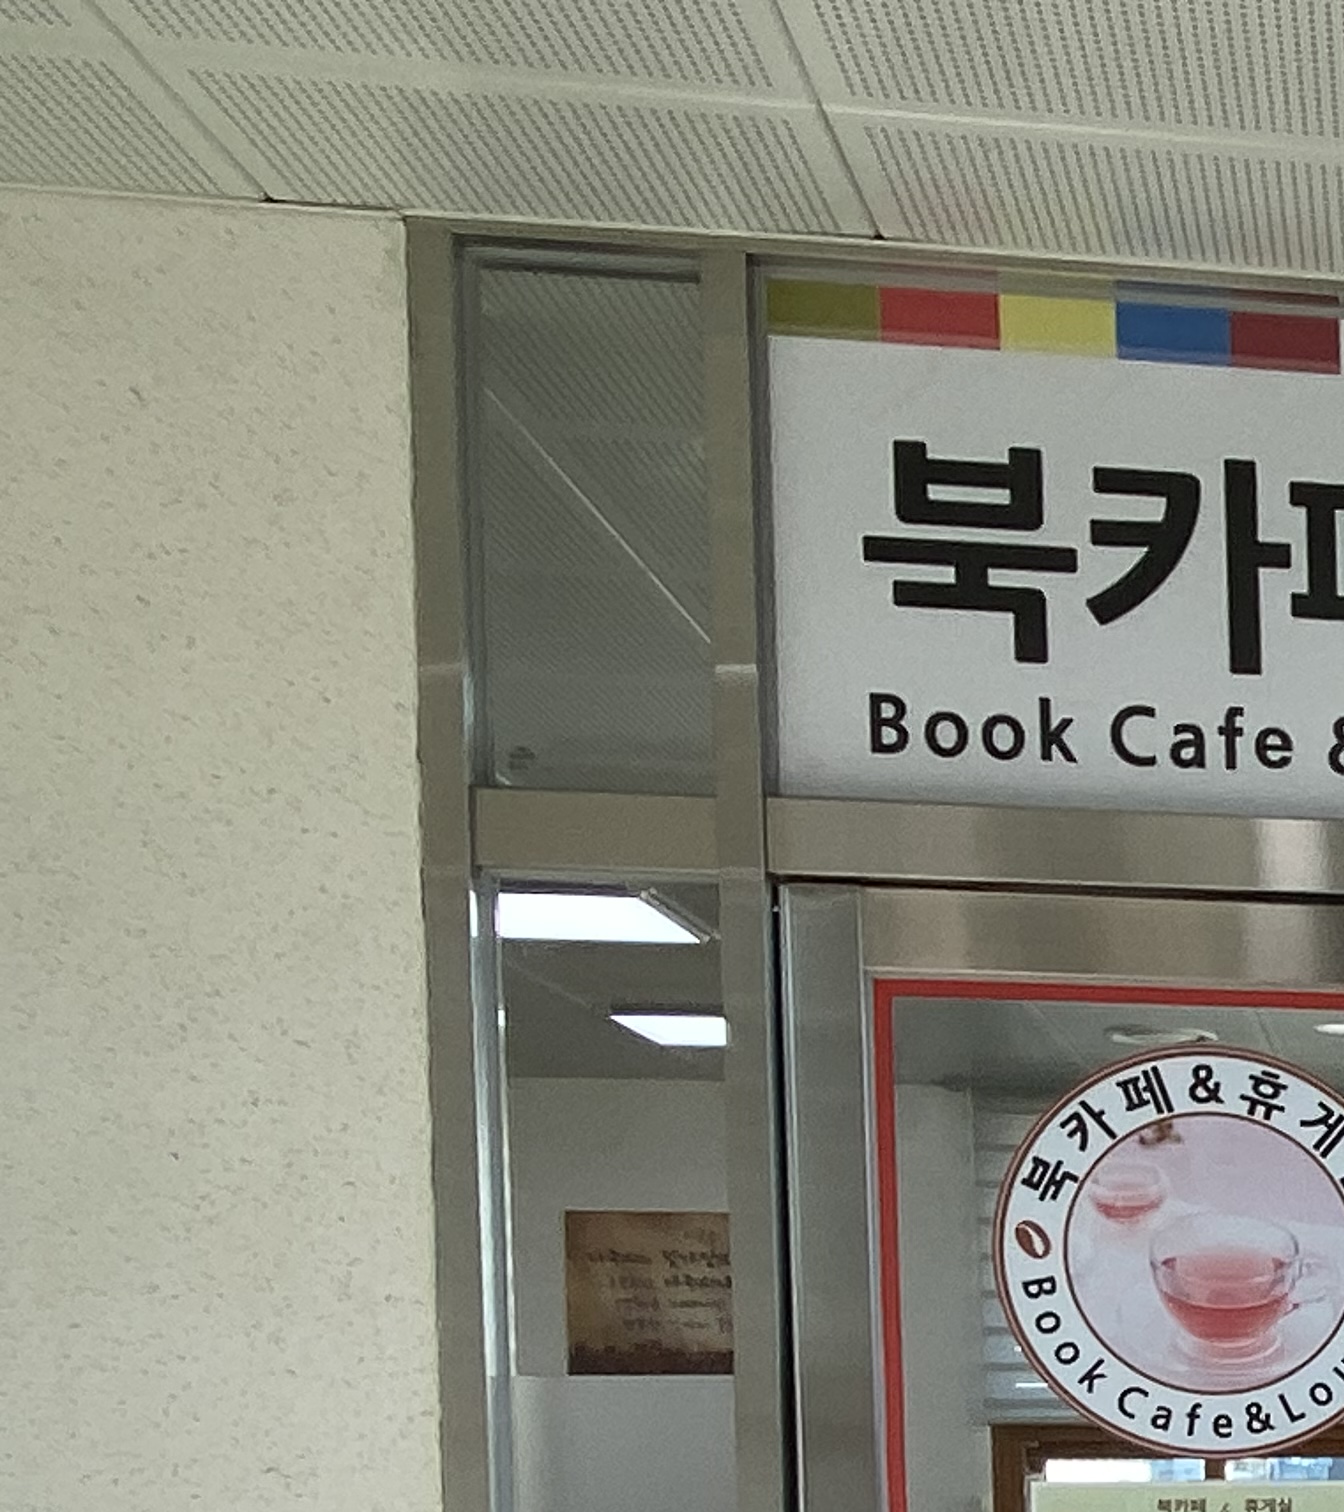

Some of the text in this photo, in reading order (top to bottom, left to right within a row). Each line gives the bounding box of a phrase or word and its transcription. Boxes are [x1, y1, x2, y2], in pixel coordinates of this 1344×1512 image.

[868, 692, 1078, 764] Book
[1110, 705, 1294, 771] Cafe
[1022, 1275, 1109, 1394] Book
